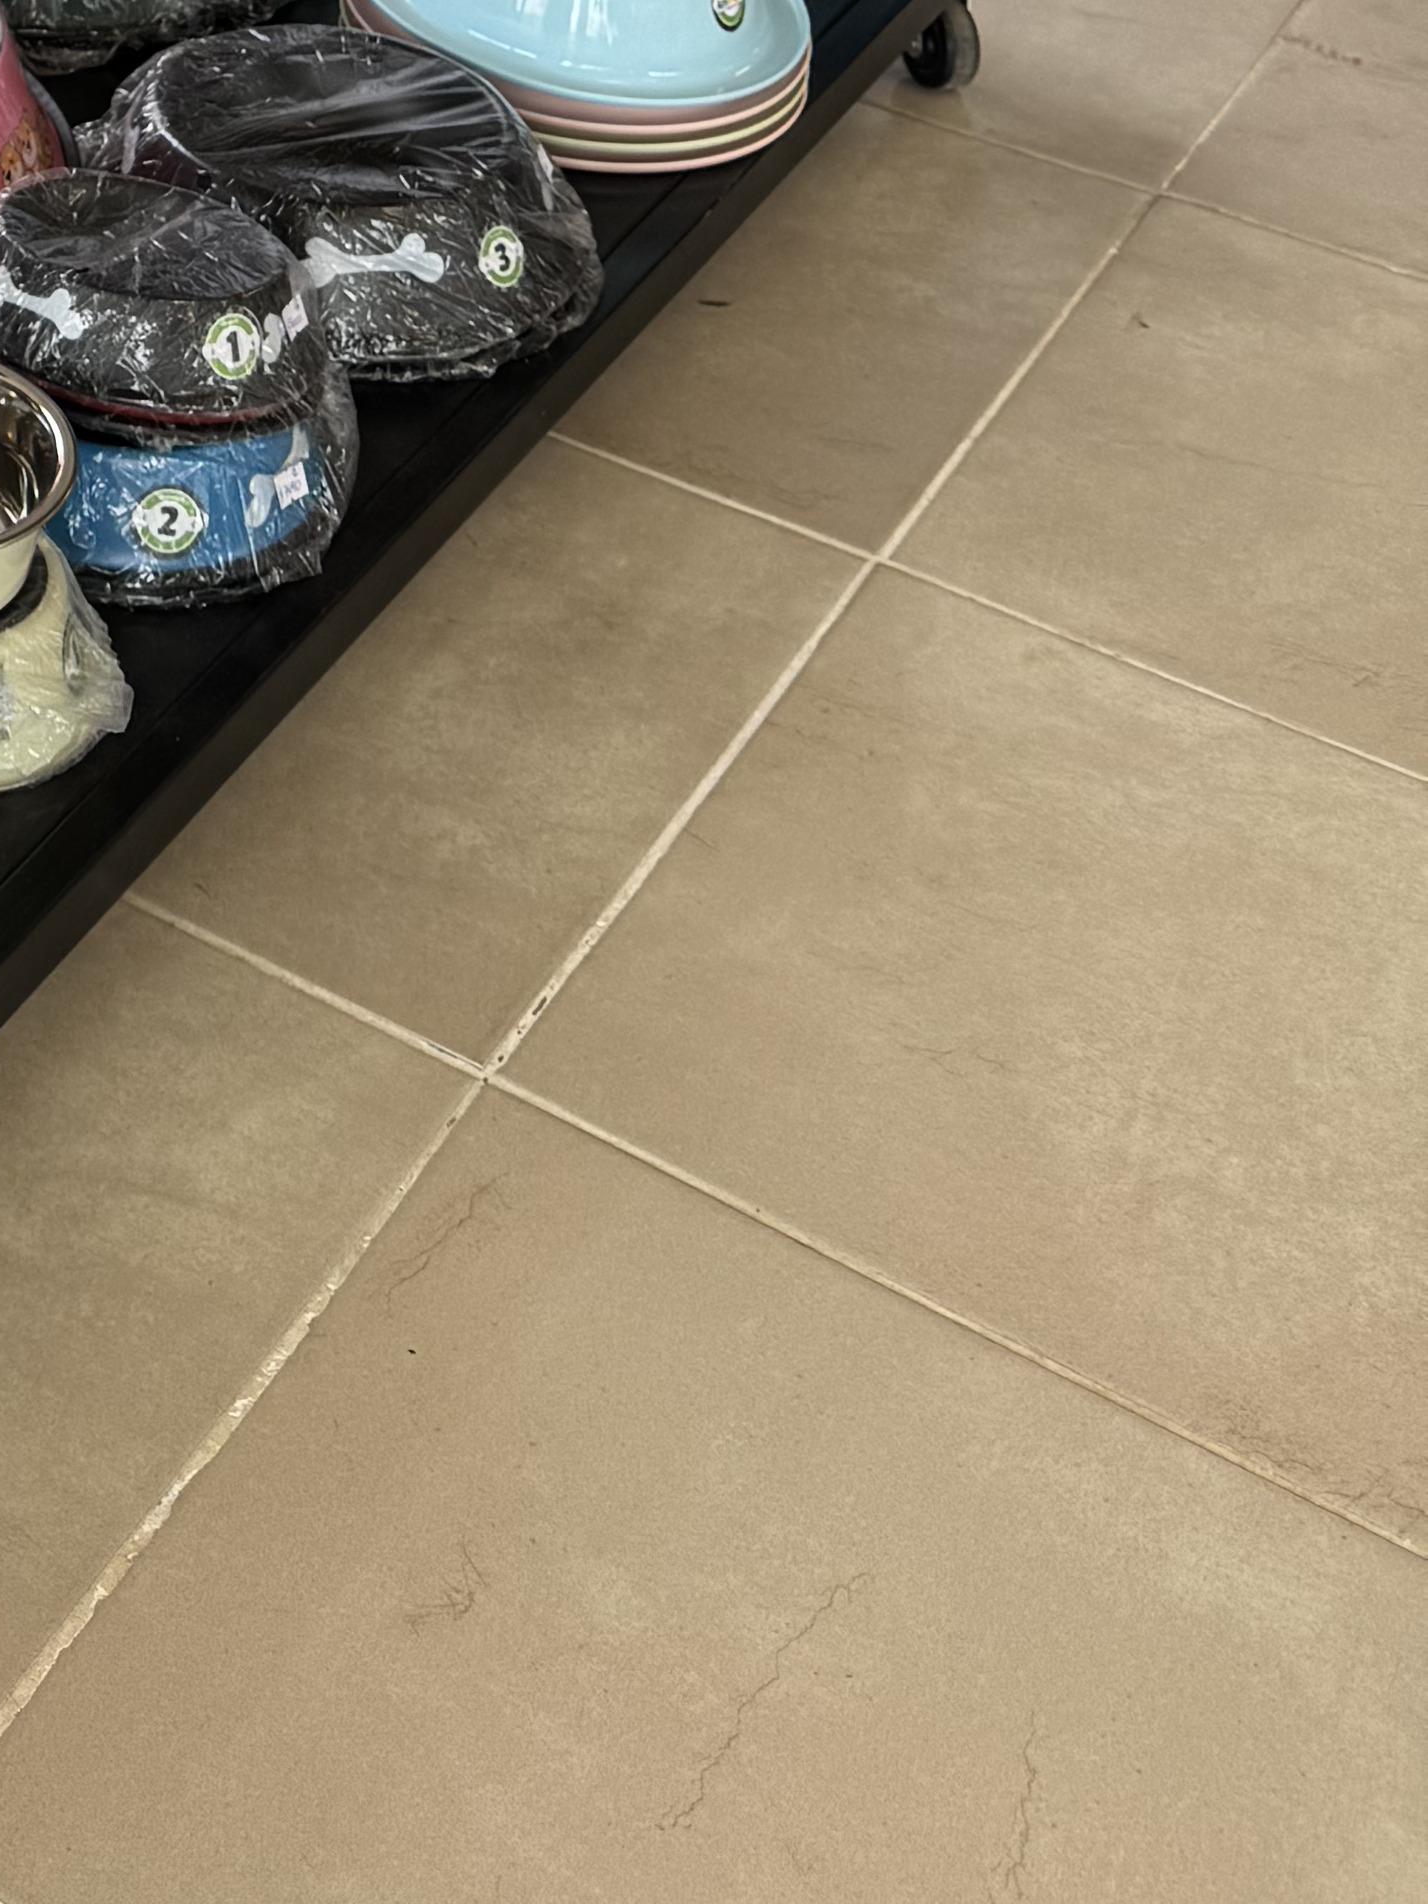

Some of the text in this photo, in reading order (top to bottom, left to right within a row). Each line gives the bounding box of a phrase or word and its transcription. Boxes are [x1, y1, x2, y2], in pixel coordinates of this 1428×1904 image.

[494, 242, 511, 273] 3
[226, 330, 241, 363] 1
[157, 505, 180, 537] 2
